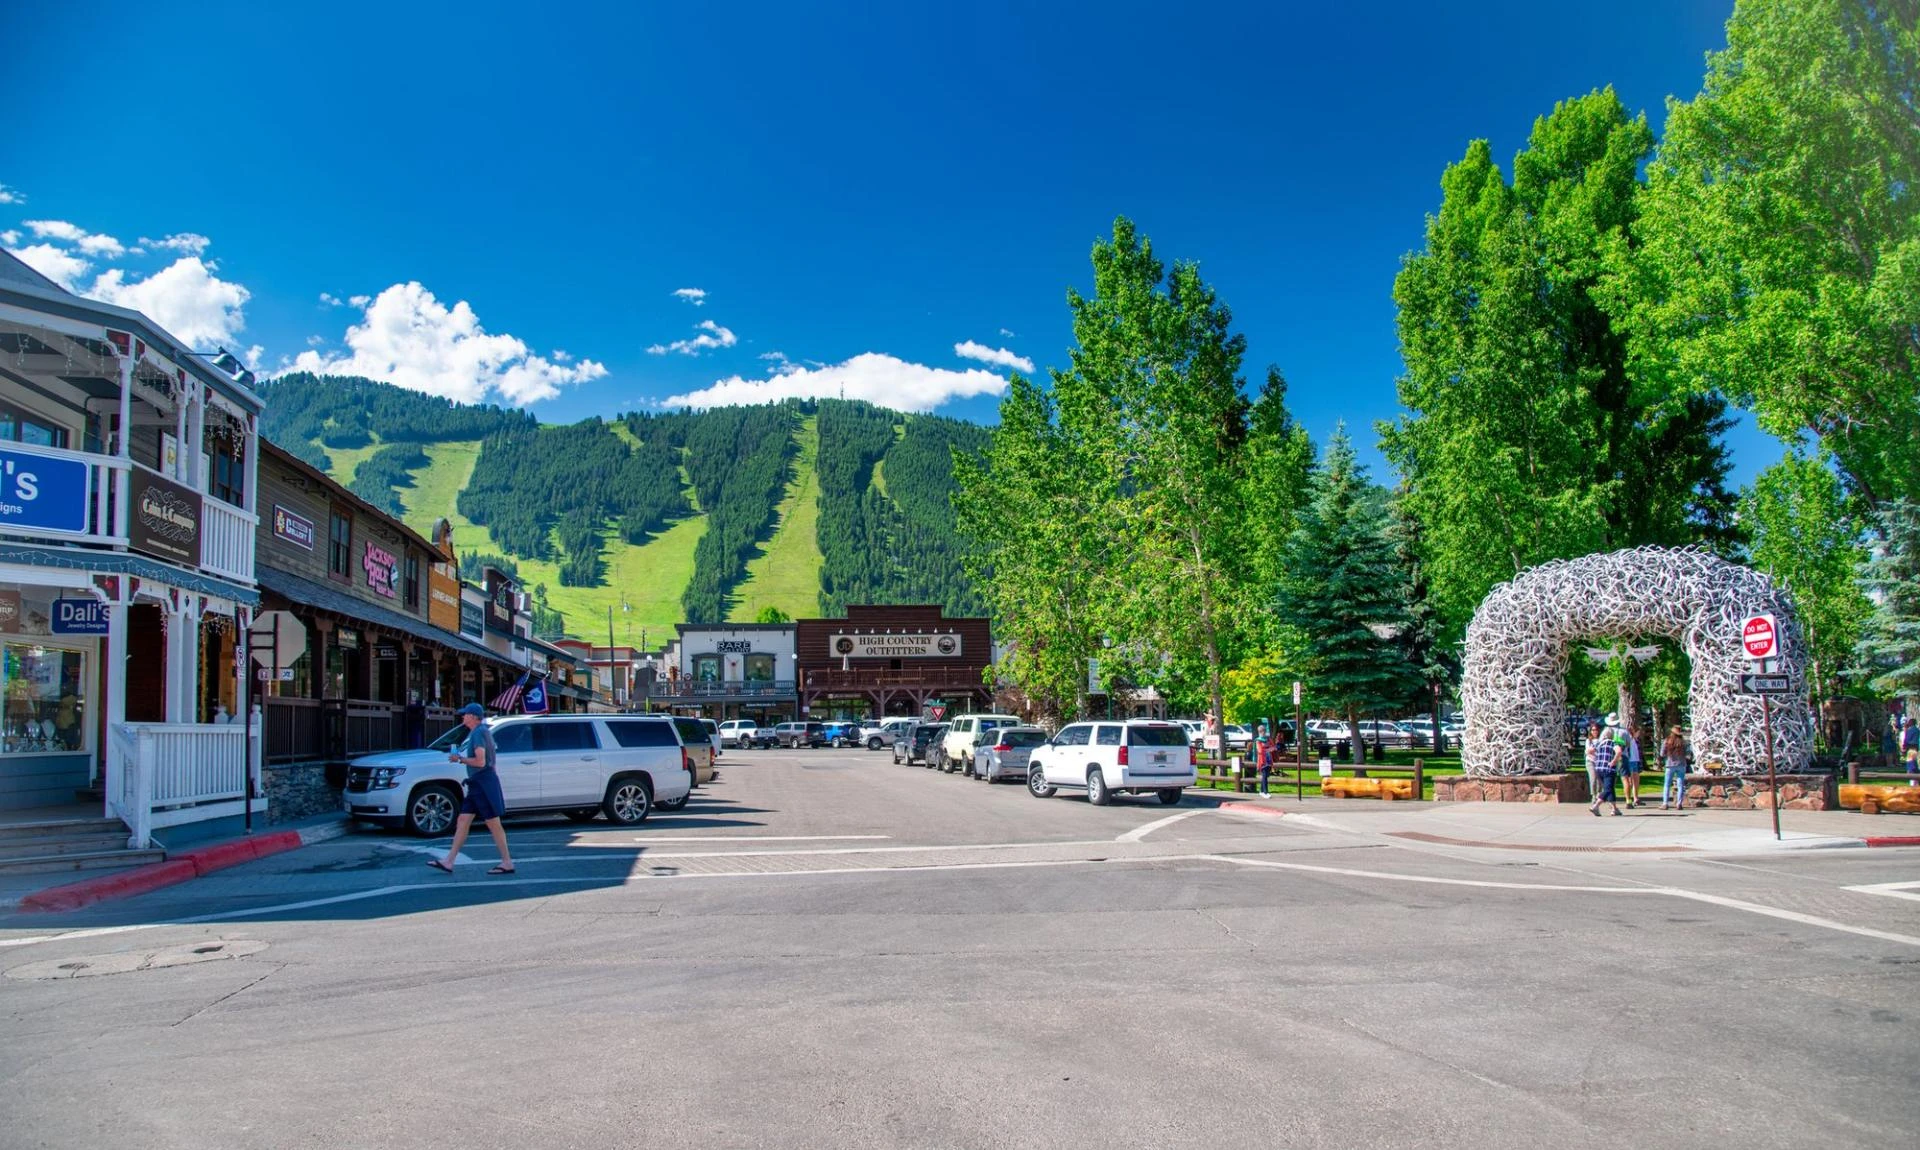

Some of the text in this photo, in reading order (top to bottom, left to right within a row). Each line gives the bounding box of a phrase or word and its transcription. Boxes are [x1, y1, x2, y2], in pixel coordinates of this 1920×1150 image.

[61, 602, 110, 622] Dali's
[859, 636, 932, 645] HIGH COUNTRY
[1750, 641, 1768, 650] ENTER
[866, 646, 926, 655] OUTFITTERS
